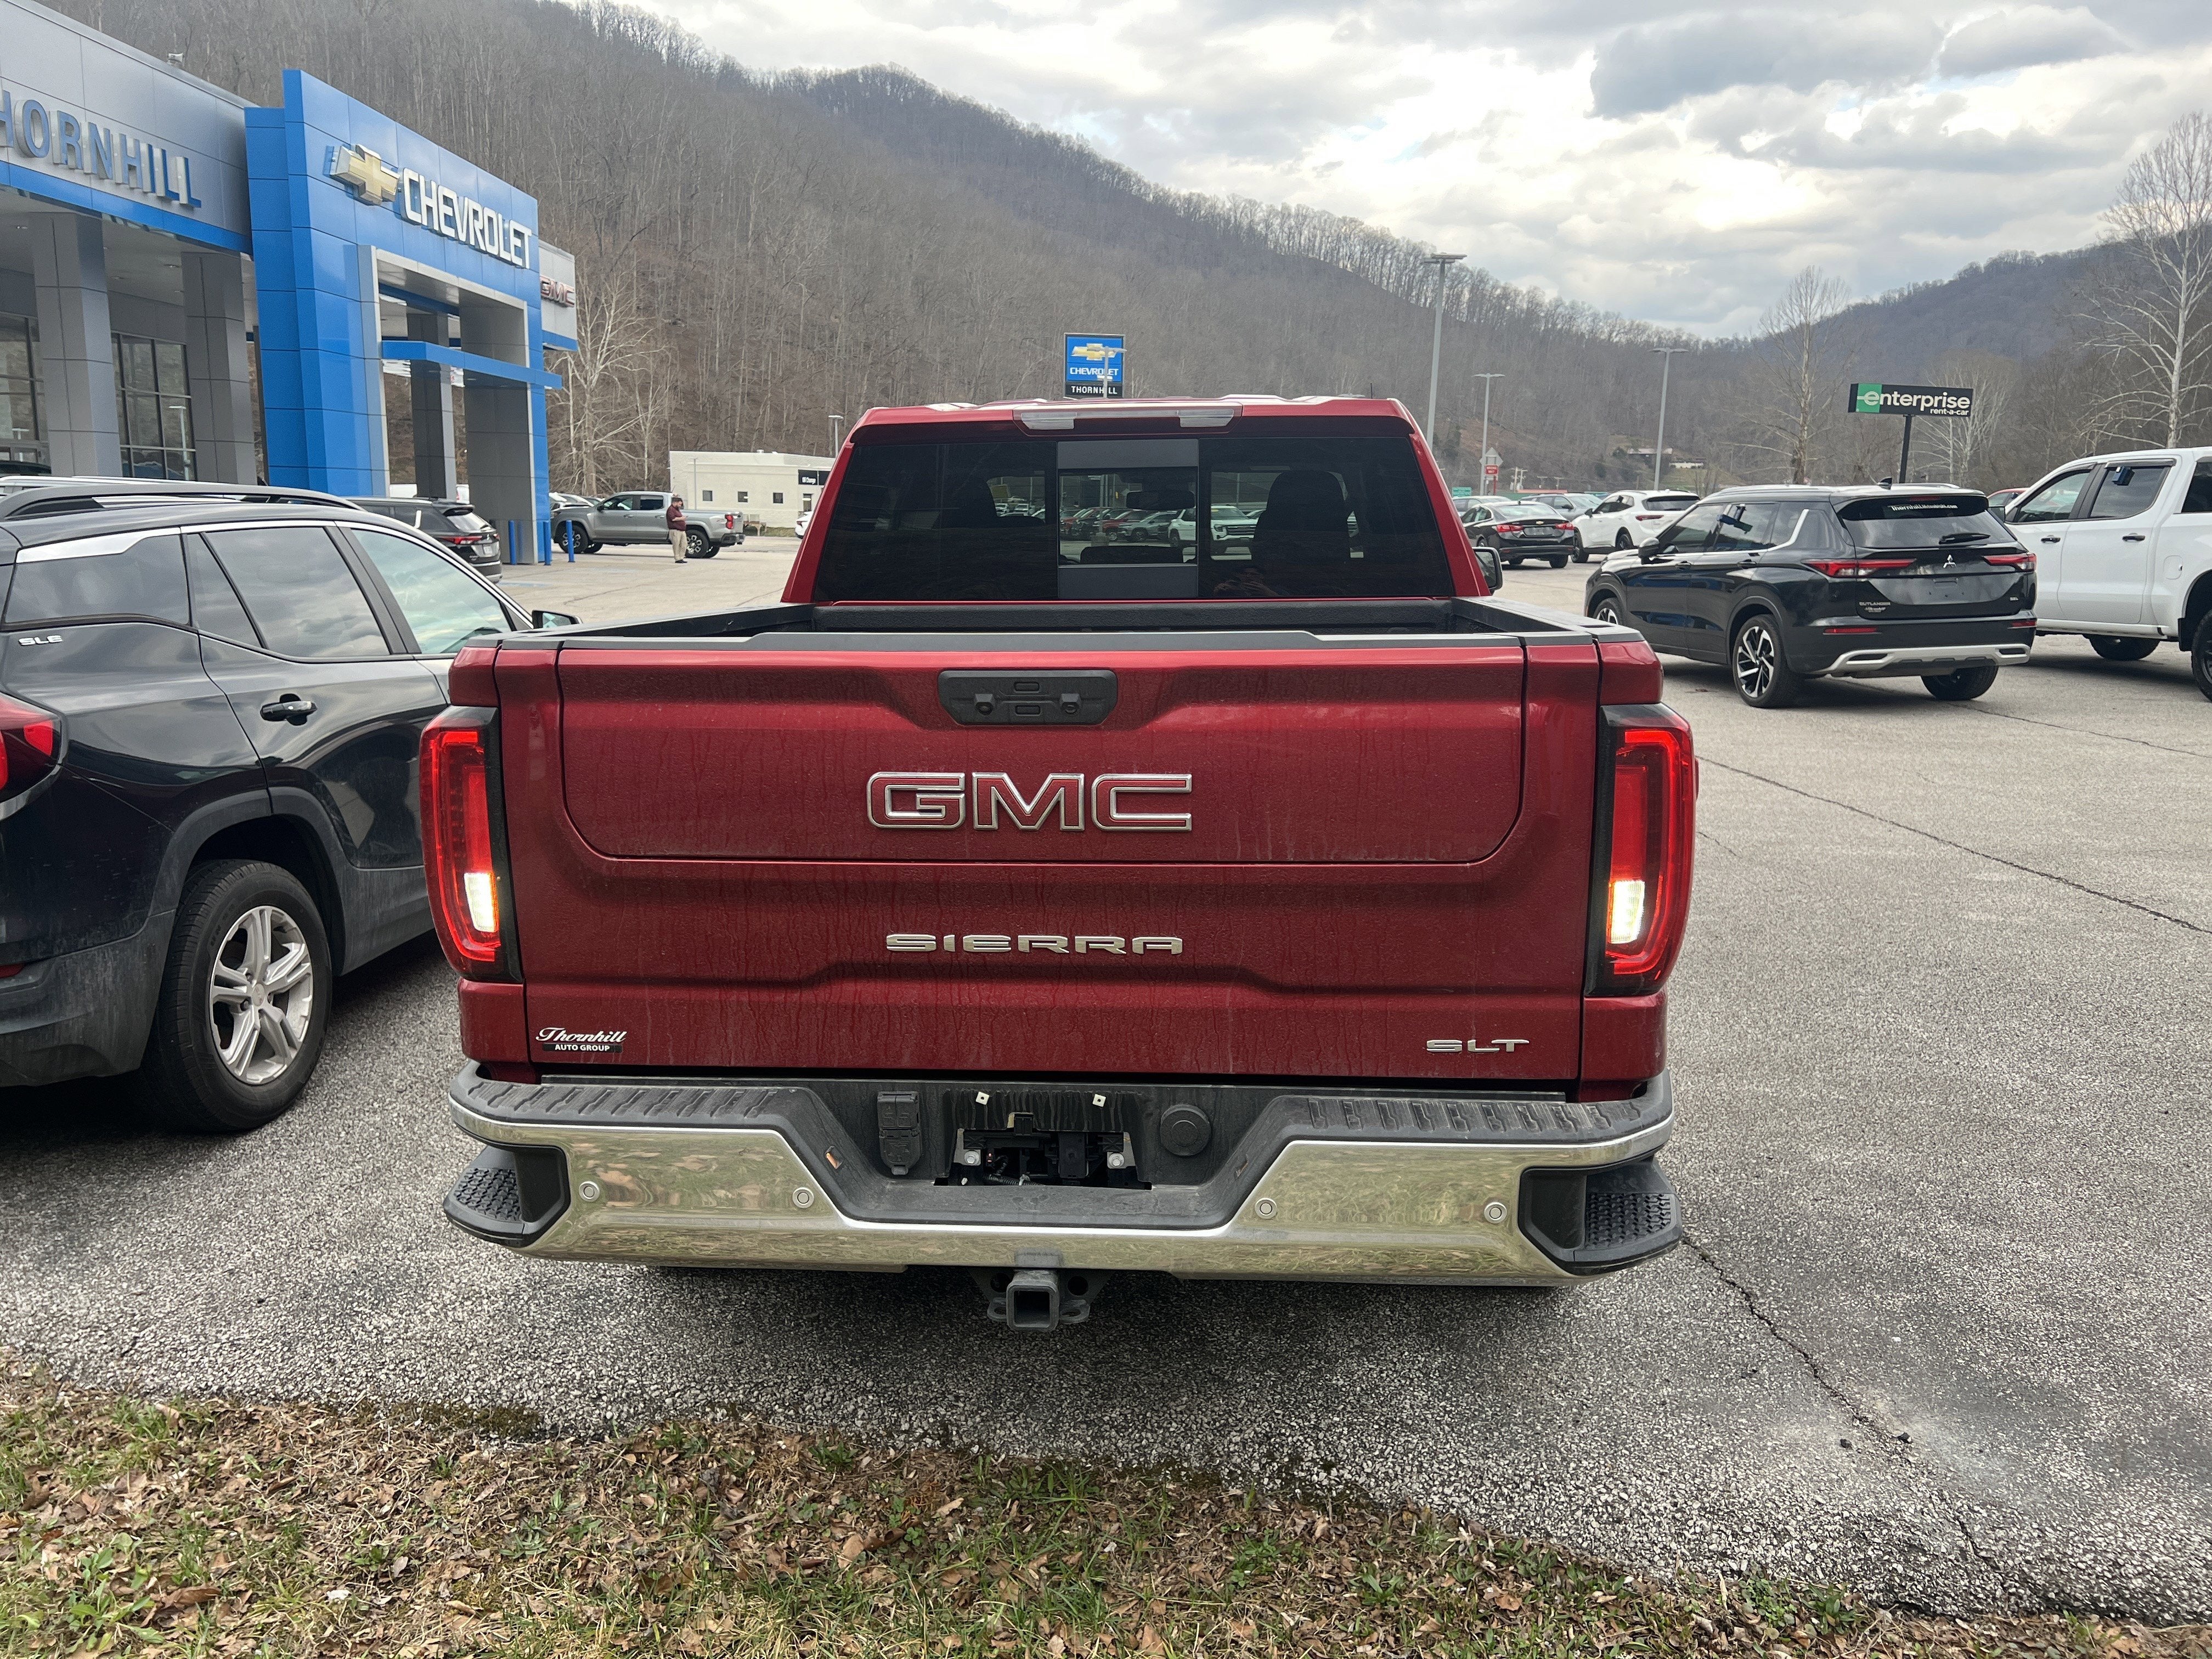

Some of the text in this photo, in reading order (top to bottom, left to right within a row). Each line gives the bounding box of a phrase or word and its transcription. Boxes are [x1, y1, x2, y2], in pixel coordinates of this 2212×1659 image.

[402, 167, 532, 269] CHEVROLET
[539, 275, 575, 308] GMC
[1070, 367, 1119, 375] CHEVROET
[1071, 386, 1118, 394] THORNHLL
[1858, 391, 1971, 411] enterprise
[19, 635, 63, 646] SLE
[867, 771, 1193, 832] GMC
[886, 934, 1183, 955] SIERRA
[535, 1026, 628, 1043] Thornhill
[1426, 1039, 1530, 1052] SLT
